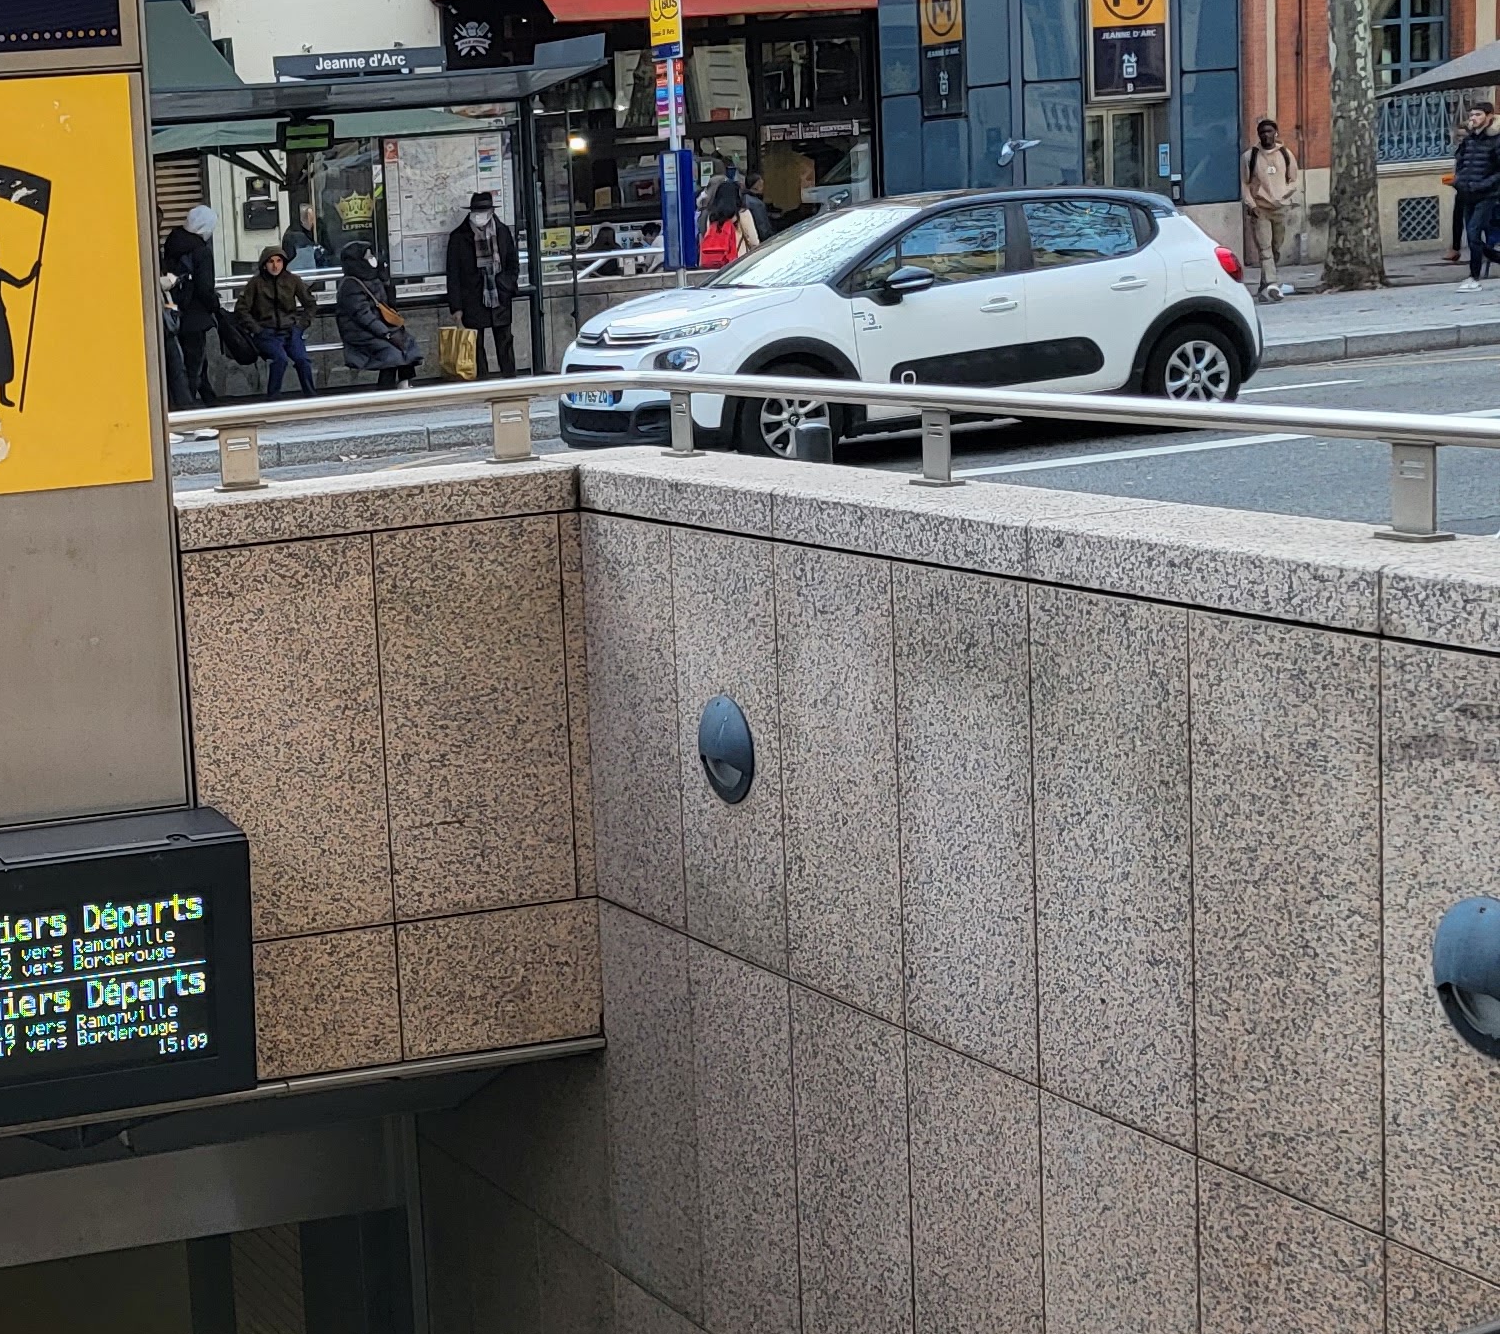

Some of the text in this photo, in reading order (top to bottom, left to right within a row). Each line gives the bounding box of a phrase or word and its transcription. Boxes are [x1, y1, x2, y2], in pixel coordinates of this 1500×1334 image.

[1101, 28, 1157, 40] JEANNE D'ARC
[315, 53, 407, 71] Jeanne d'Arc
[83, 893, 203, 935] Départs
[21, 944, 63, 962] vers
[72, 927, 176, 954] Ramonville
[21, 960, 64, 977] vers
[73, 945, 176, 971] Borderouge
[86, 969, 206, 1010] Départs
[25, 1020, 67, 1037] vers
[76, 1003, 179, 1030] Ramonville
[26, 1036, 68, 1053] vers
[77, 1020, 179, 1047] Borderouge
[158, 1032, 208, 1055] 15:09
